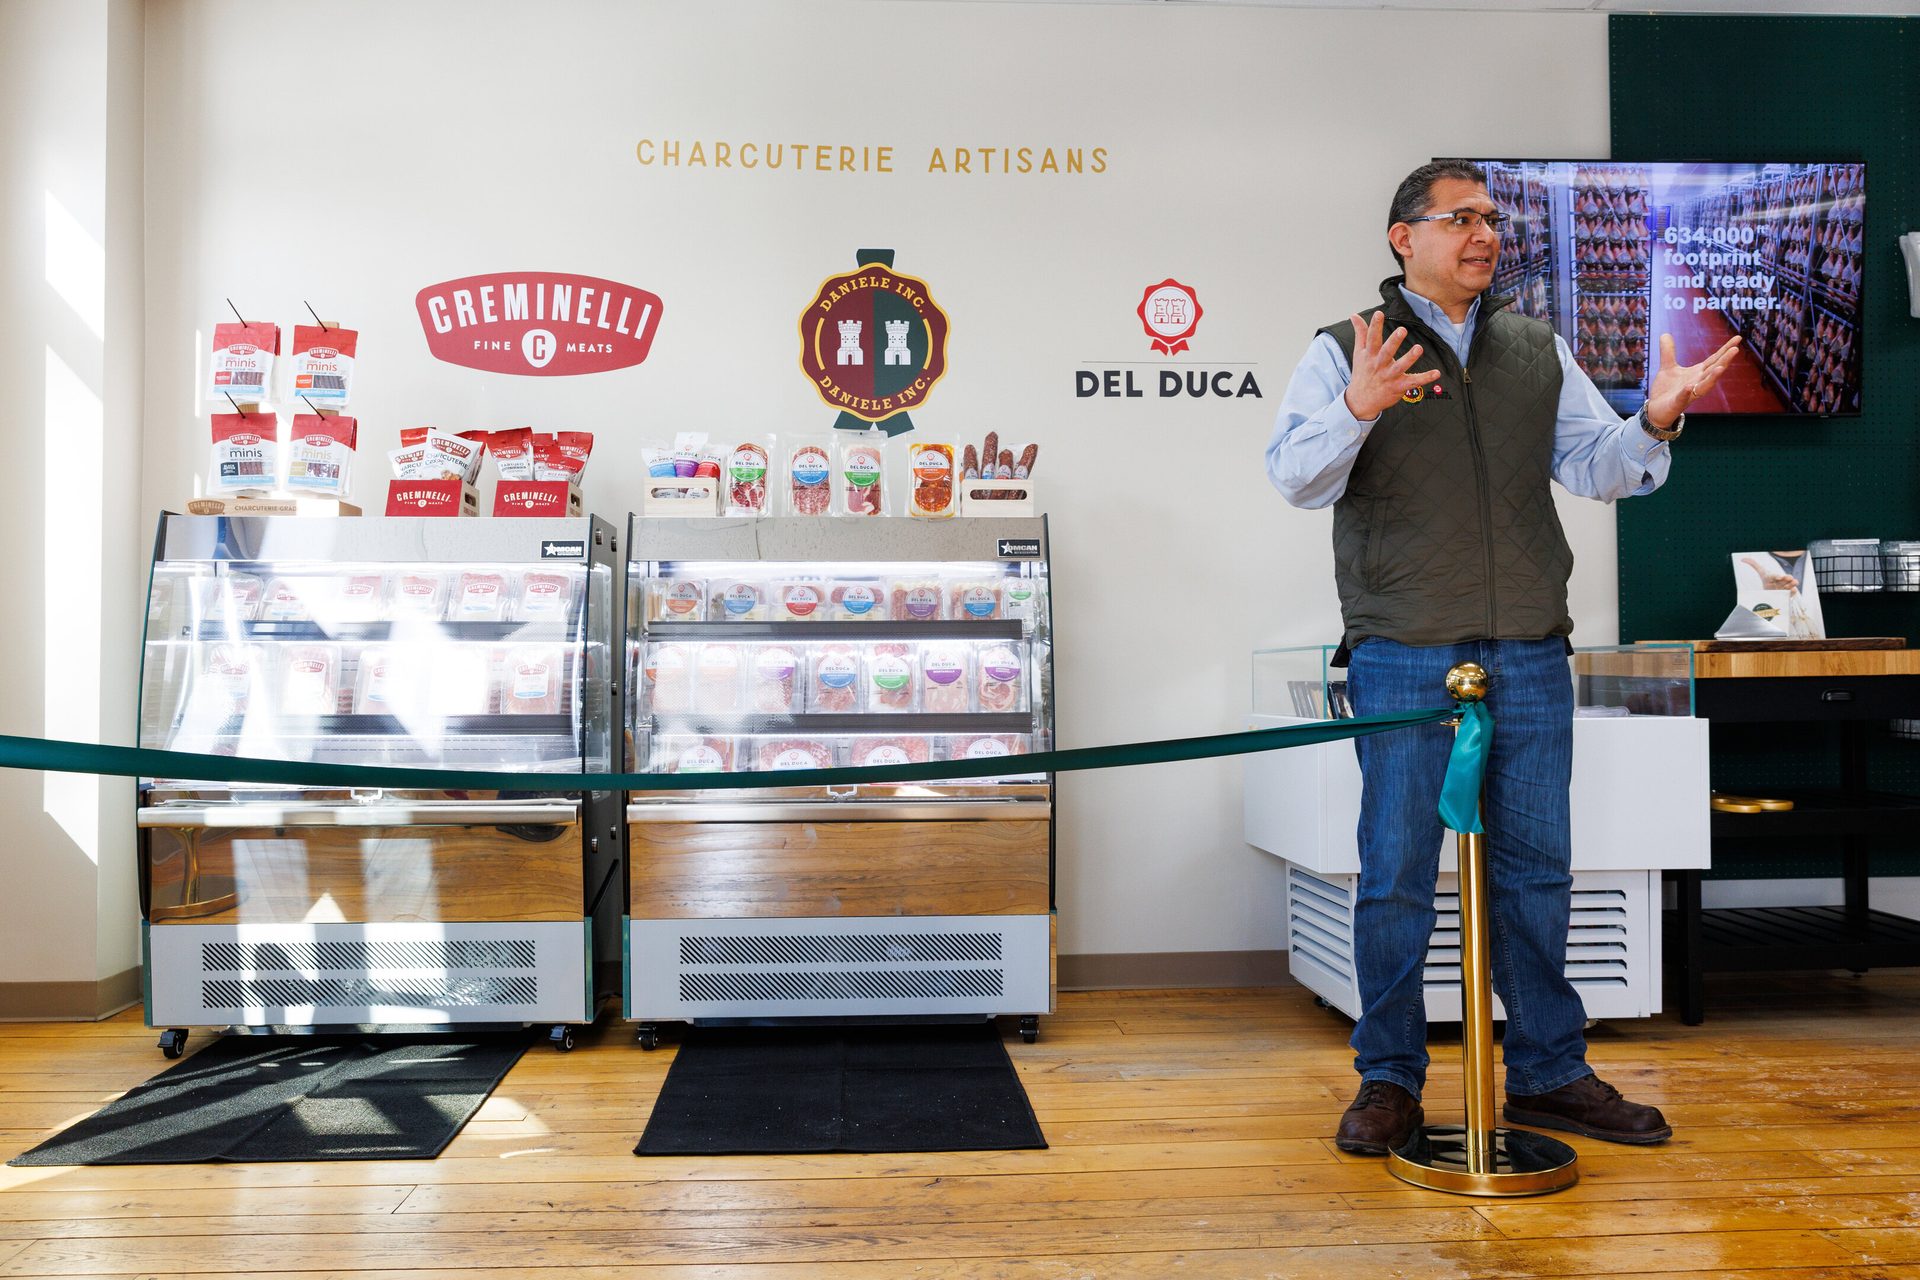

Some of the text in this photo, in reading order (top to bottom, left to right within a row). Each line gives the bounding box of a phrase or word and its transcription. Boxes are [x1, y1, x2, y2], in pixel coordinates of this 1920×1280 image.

[636, 139, 1108, 173] CHARCUTERIE ARTISANS
[1664, 226, 1754, 247] 634,000
[1663, 248, 1761, 269] footprint
[1663, 271, 1776, 293] and ready
[820, 277, 925, 313] DANIELE INC.
[1664, 294, 1781, 314] to partner.
[428, 283, 652, 339] CREMINELLI
[474, 340, 613, 353] FINE MEATS
[225, 358, 256, 368] minis
[306, 362, 338, 372] minis
[820, 376, 931, 411] DANIELE INC.
[1076, 370, 1263, 398] DEL DUCA
[229, 448, 262, 458] minis
[301, 450, 332, 460] minis
[432, 438, 470, 456] CREMINELLI
[396, 490, 450, 502] CREMINELLI
[504, 492, 557, 503] CREMINELLI
